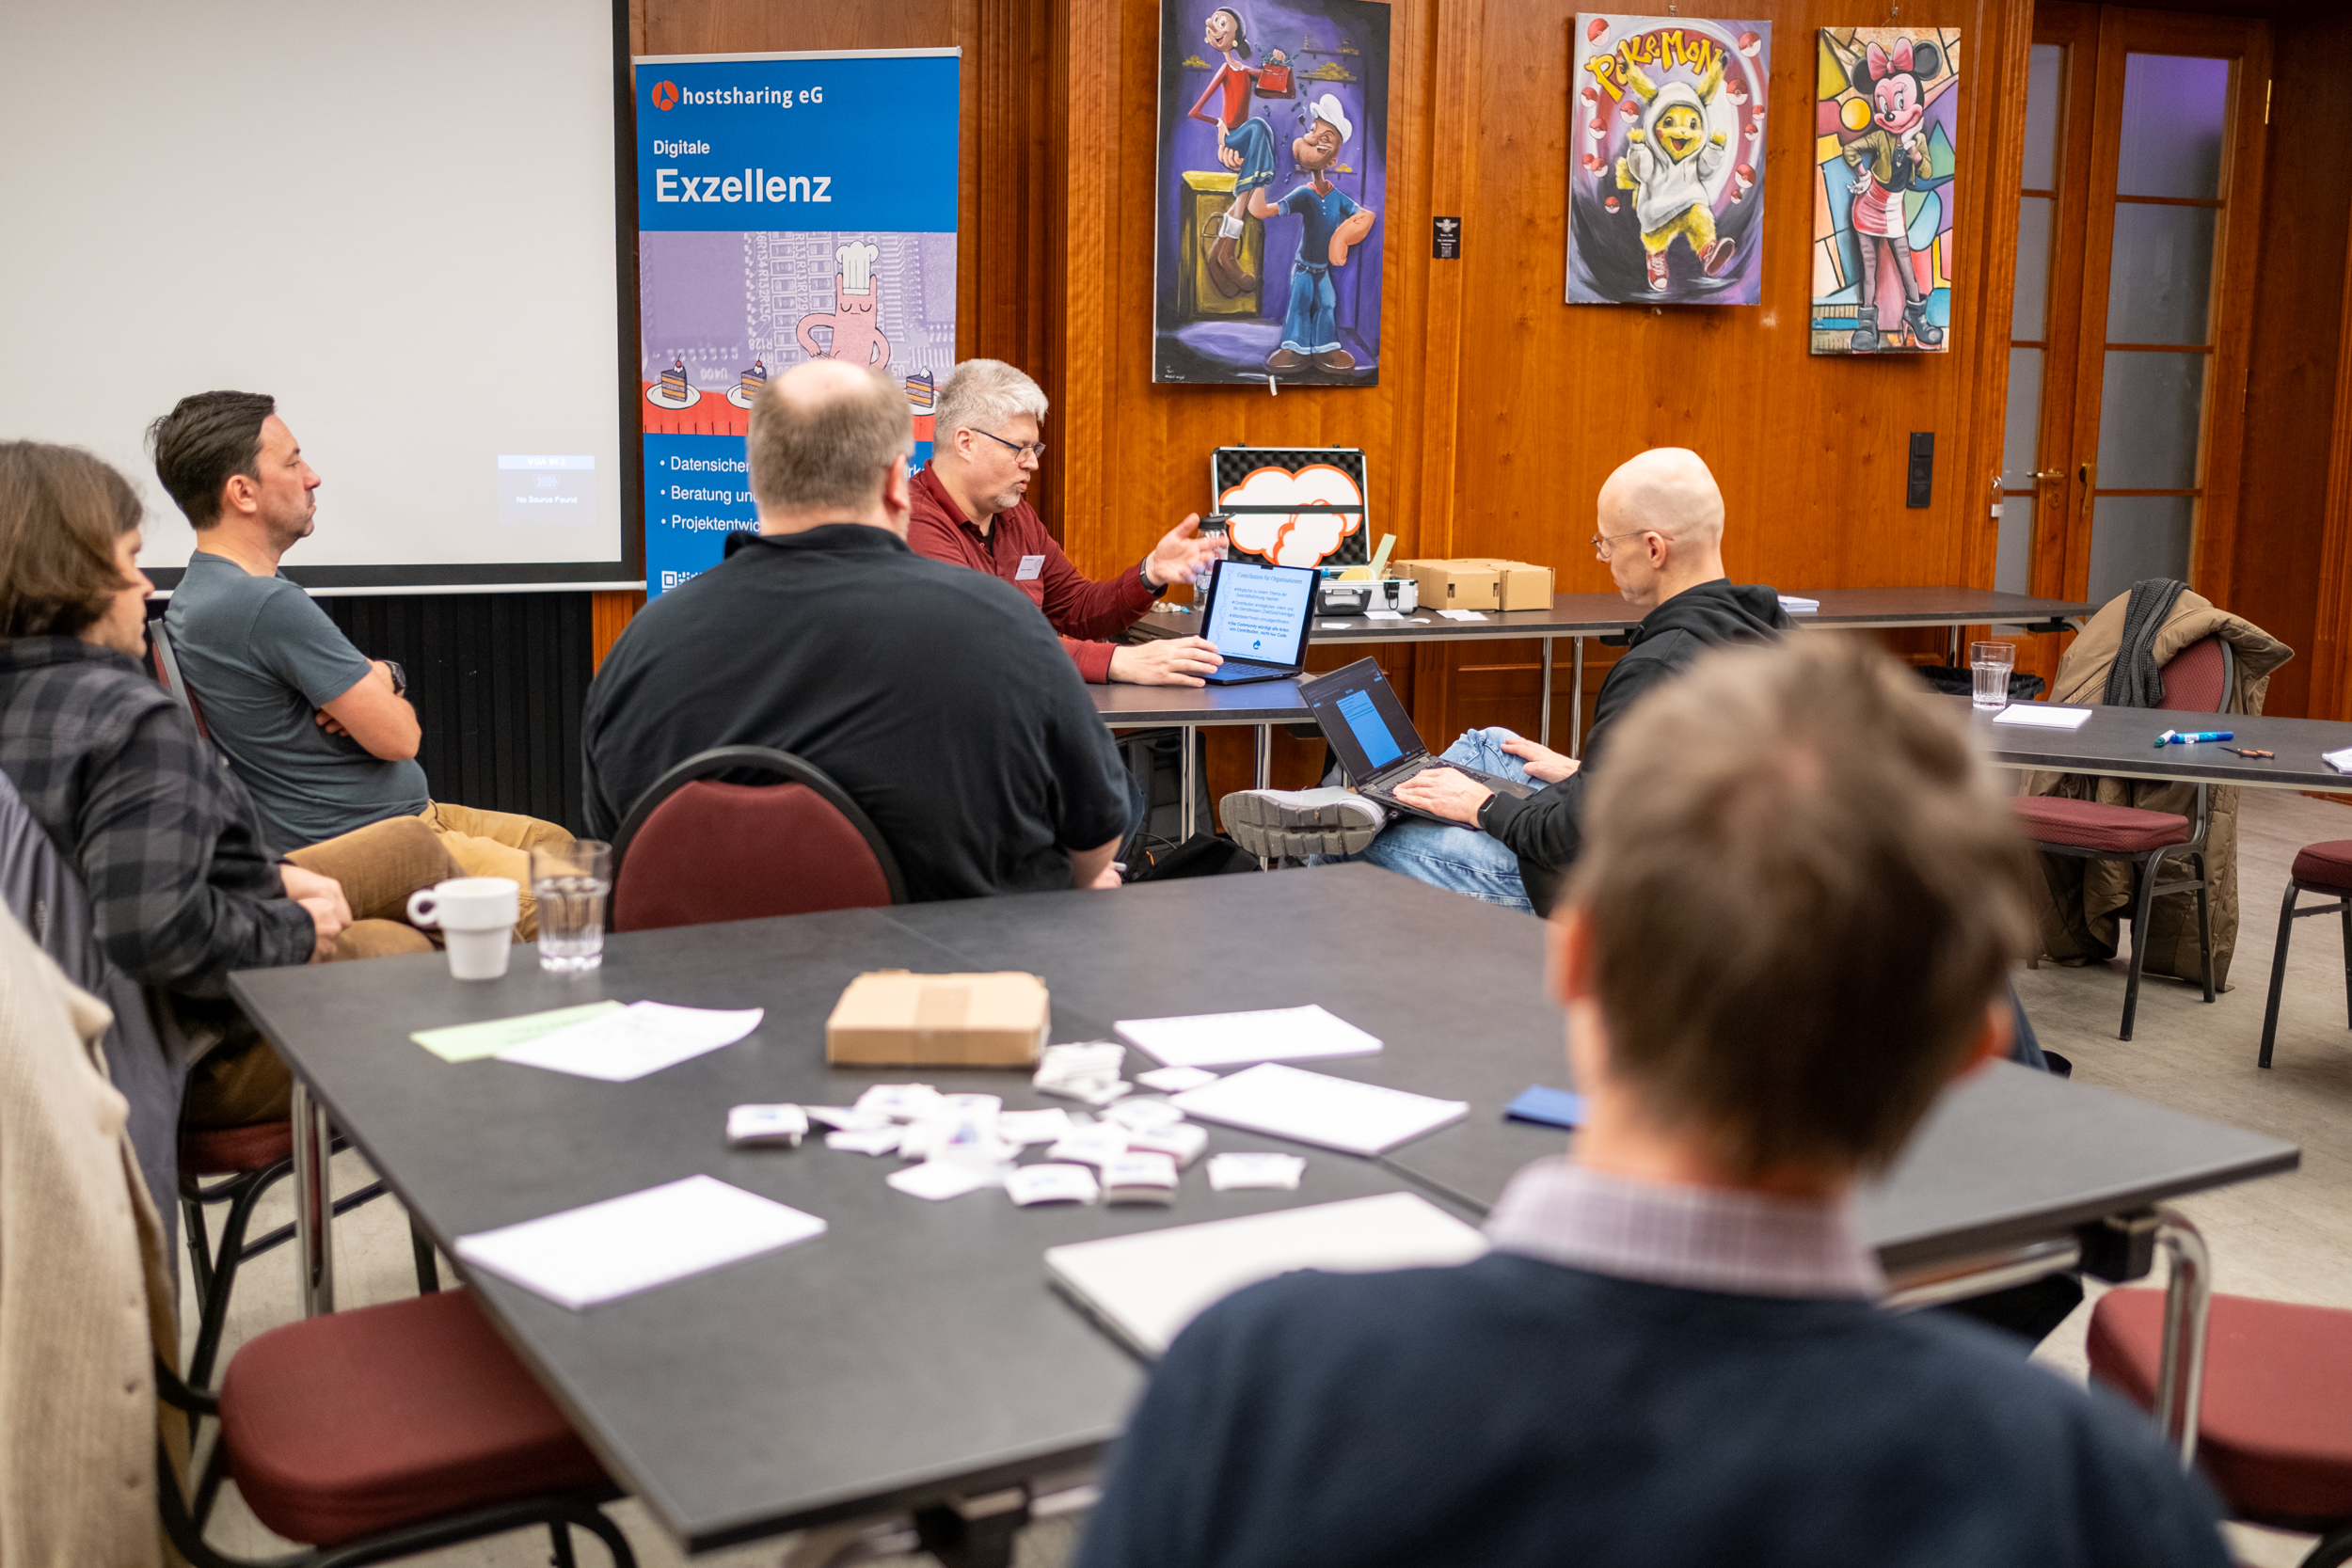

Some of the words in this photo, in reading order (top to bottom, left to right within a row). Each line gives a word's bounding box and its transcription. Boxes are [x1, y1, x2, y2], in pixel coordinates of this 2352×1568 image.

[682, 86, 793, 109] hostsharing
[799, 86, 823, 103] eG
[653, 139, 710, 158] Digitale
[656, 167, 832, 202] Exzellenz
[795, 233, 806, 260] R133
[797, 261, 808, 286] R131
[798, 285, 809, 311] R129
[748, 338, 772, 351] R128
[671, 484, 731, 505] Beratung
[671, 515, 760, 533] Projektentwic
